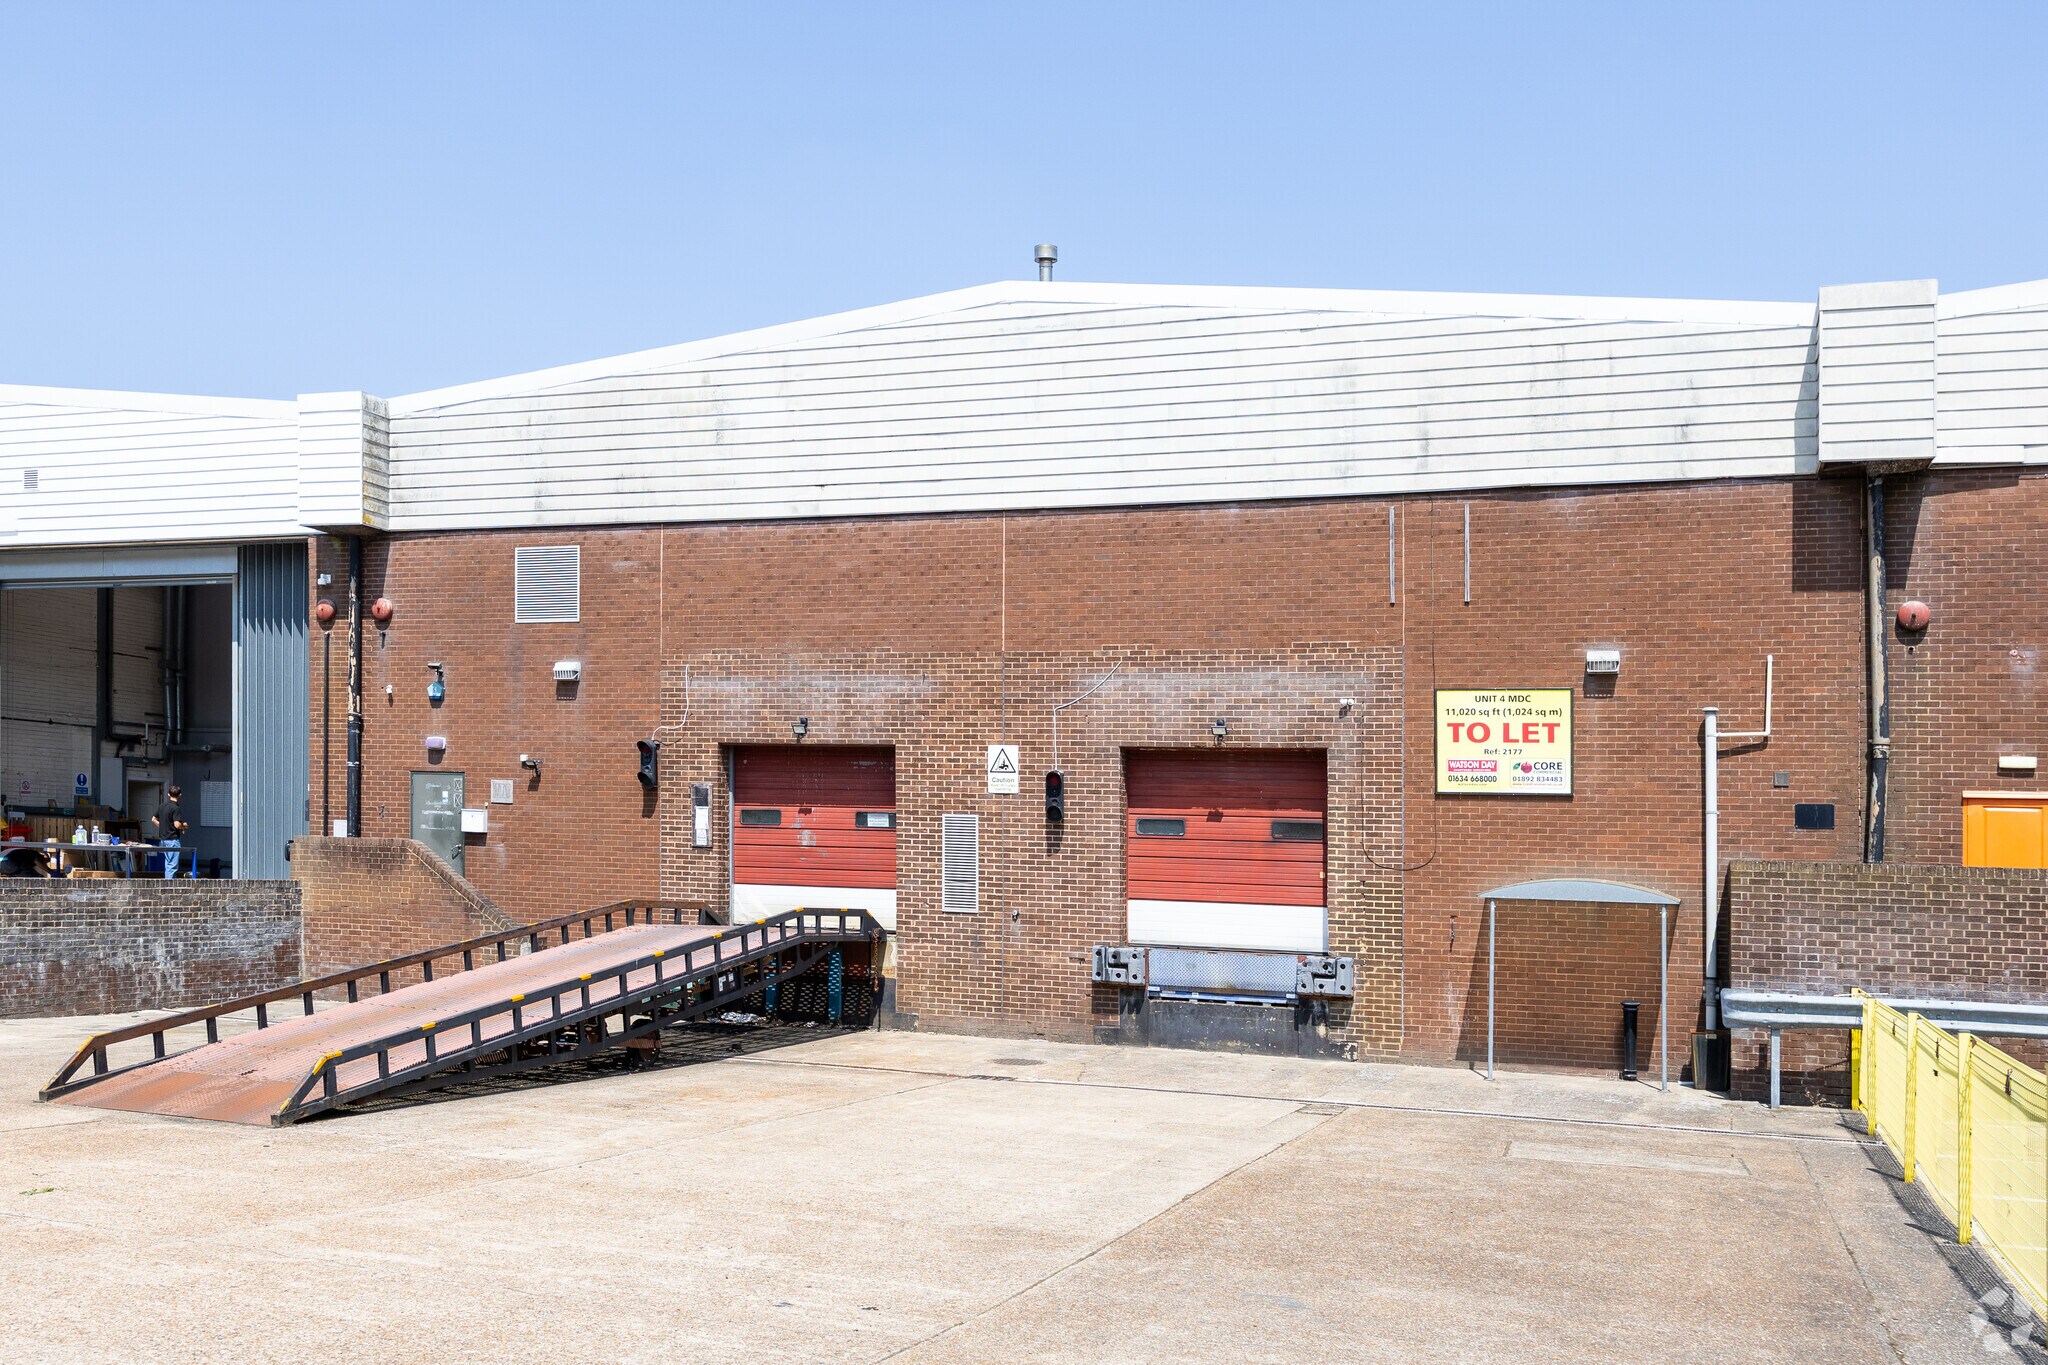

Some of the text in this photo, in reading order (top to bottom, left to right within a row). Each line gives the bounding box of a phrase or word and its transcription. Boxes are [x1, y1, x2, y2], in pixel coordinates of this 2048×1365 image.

[1475, 695, 1532, 703] UNIT 4 MDC
[1445, 708, 1563, 717] 11,020 sq ft (1,024 sq m)
[1447, 722, 1561, 743] TO LET
[1448, 761, 1496, 769] WATSON DAY
[1533, 761, 1563, 770] CORE
[1470, 775, 1498, 783] 668000
